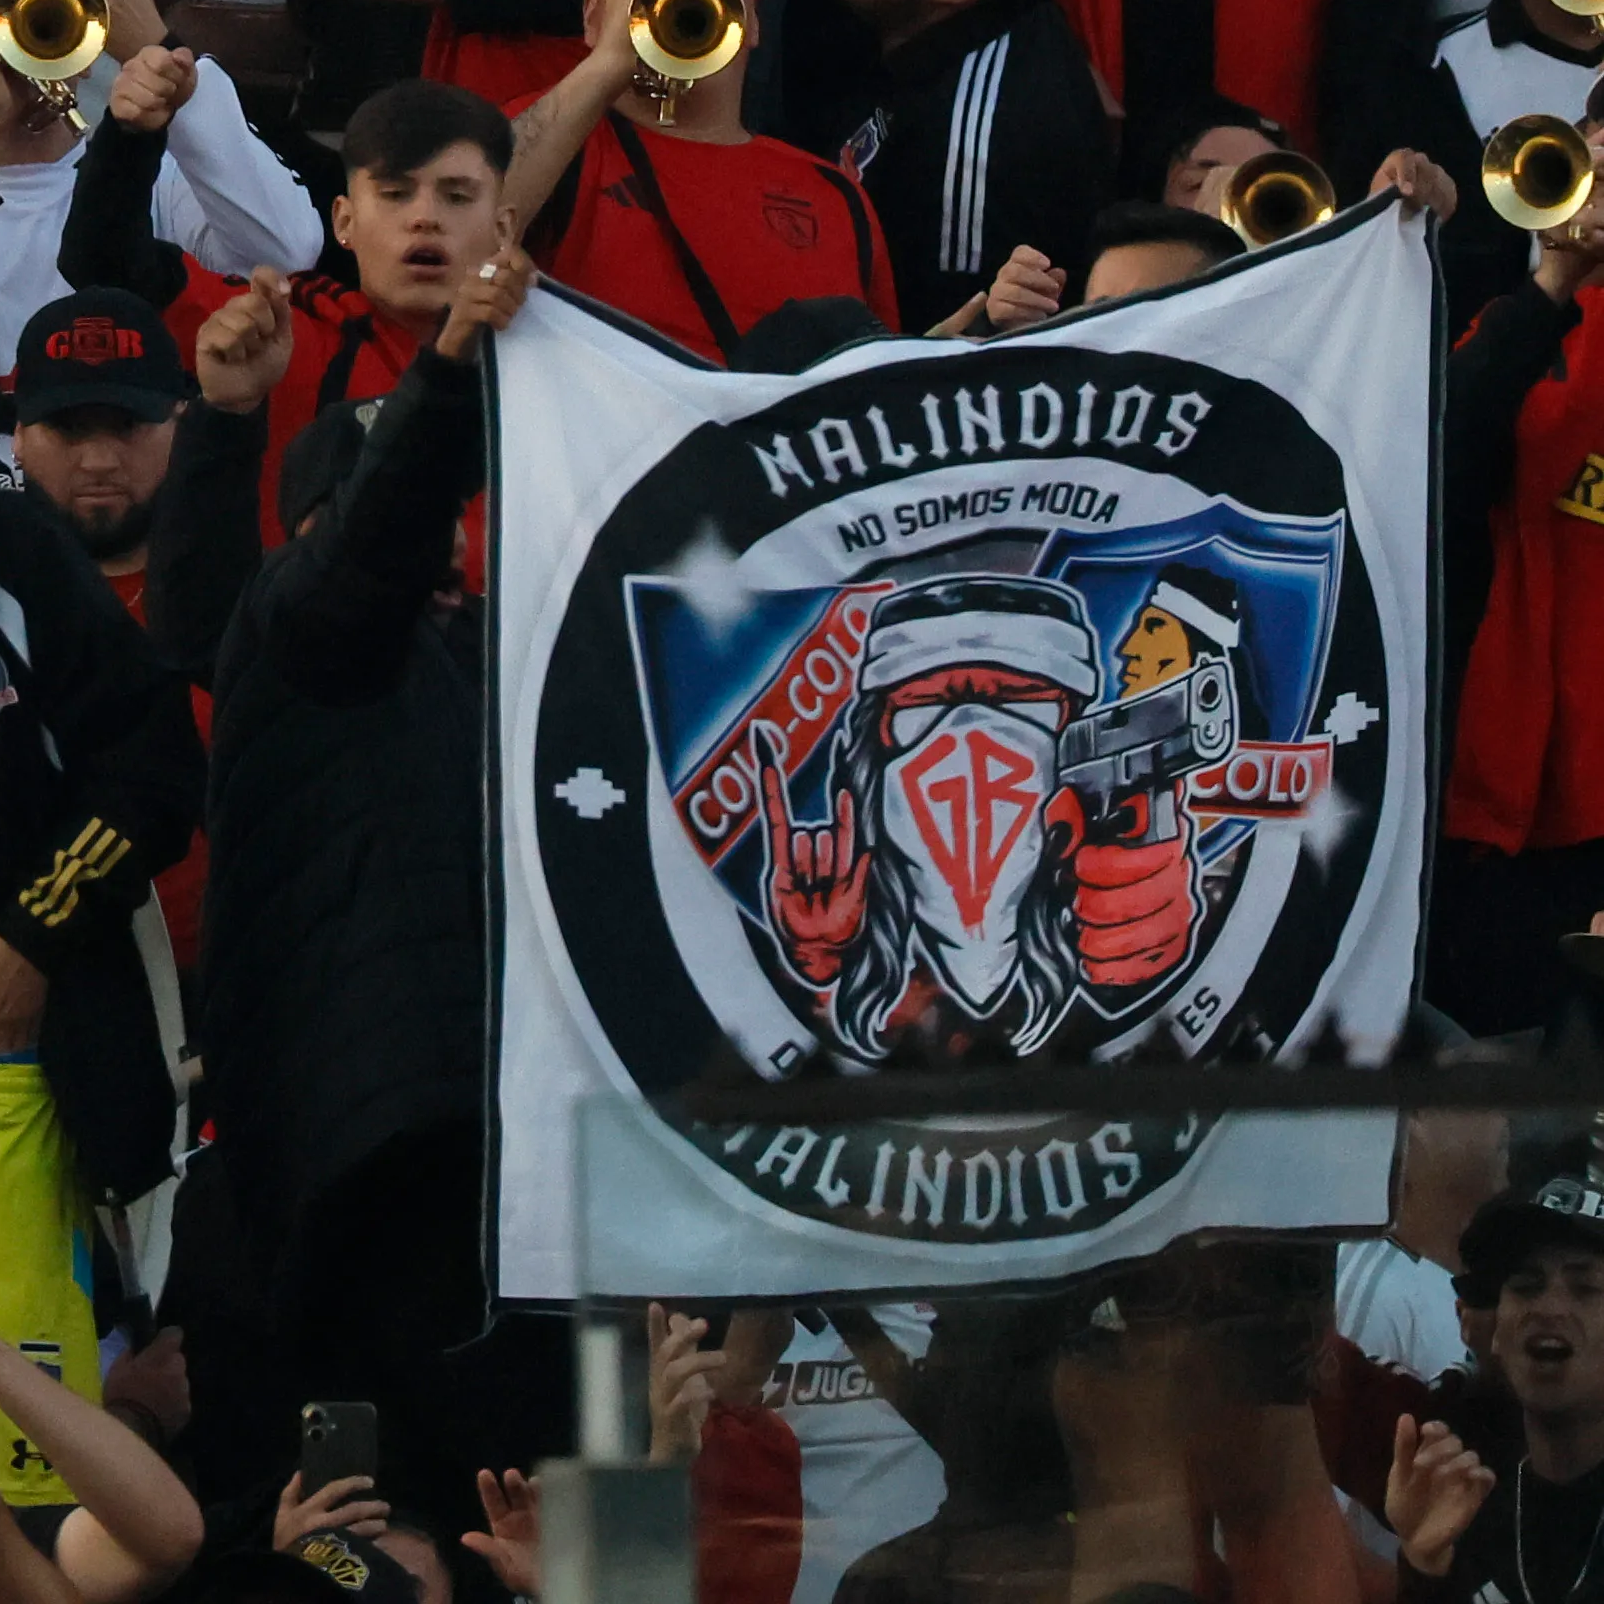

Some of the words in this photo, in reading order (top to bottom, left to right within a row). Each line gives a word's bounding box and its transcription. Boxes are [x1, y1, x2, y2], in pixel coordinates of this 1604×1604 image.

[750, 380, 1213, 499] MALINDIOS
[837, 512, 887, 553] NO
[895, 487, 1013, 537] SOMOS
[1022, 483, 1121, 526] MODA
